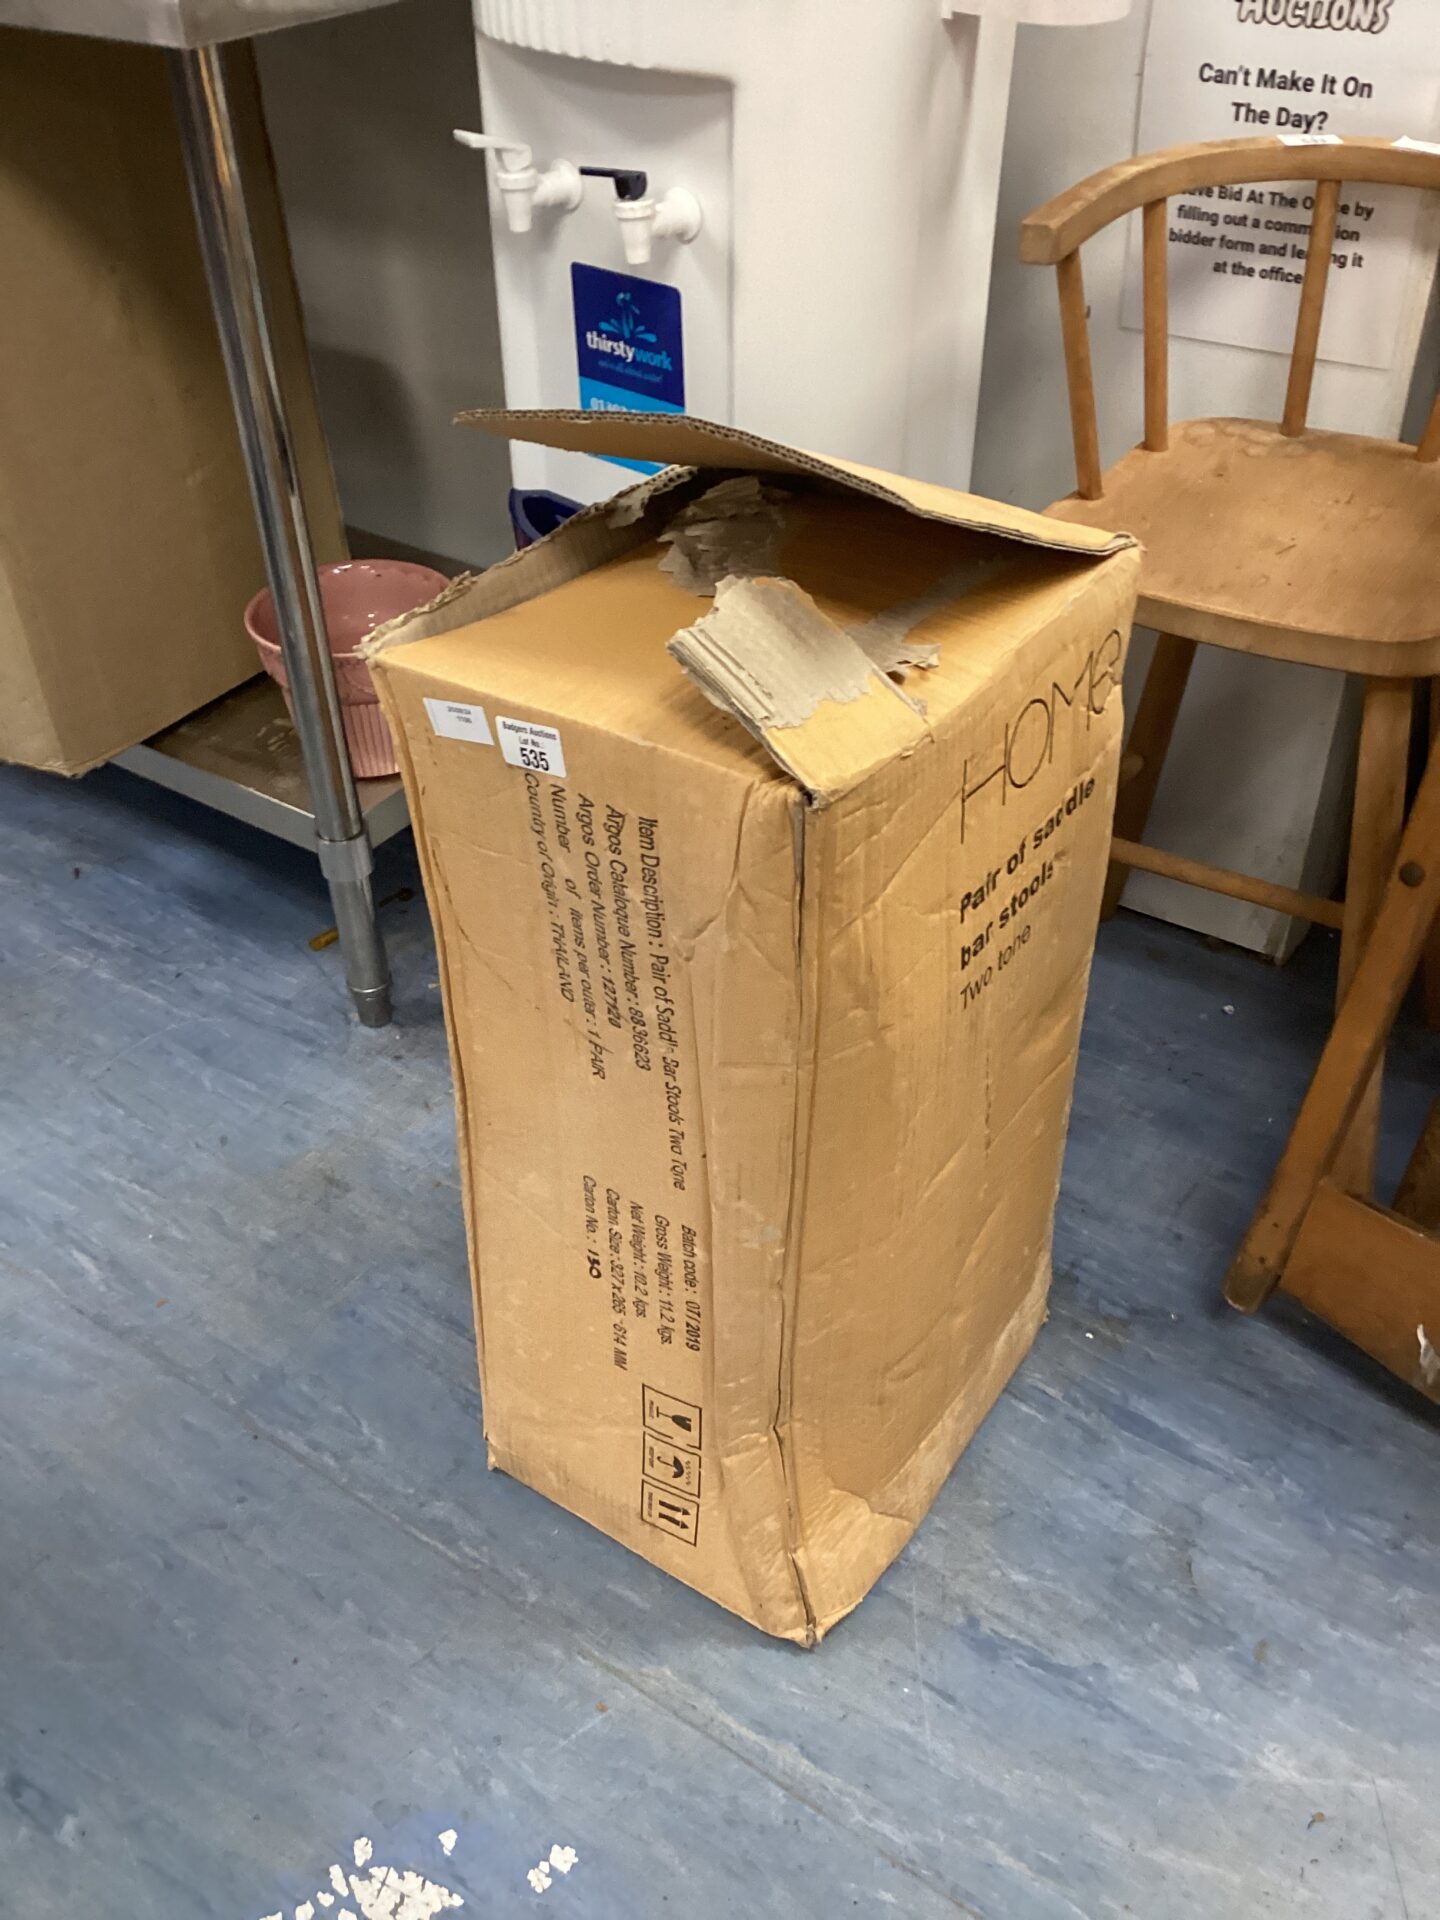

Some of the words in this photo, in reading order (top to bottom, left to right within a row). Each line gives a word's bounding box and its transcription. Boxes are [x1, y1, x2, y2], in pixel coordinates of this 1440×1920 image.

[1199, 63, 1251, 86] Can't
[1256, 68, 1315, 92] Make
[1321, 74, 1336, 95] It
[1343, 76, 1373, 98] On
[1232, 102, 1270, 124] The
[1276, 107, 1328, 134] Day?
[1177, 204, 1219, 227] filling
[1223, 213, 1248, 227] out
[1252, 219, 1260, 229] a
[1218, 185, 1243, 202] Bid
[1246, 189, 1264, 206] At
[1268, 191, 1298, 209] The
[1354, 201, 1374, 221] by
[1169, 228, 1216, 247] bidder
[1219, 235, 1255, 253] form
[1258, 242, 1287, 257] and
[1351, 252, 1364, 268] it
[1213, 260, 1228, 273] at
[1231, 261, 1255, 277] the
[961, 629, 1122, 845] HOME
[520, 746, 549, 771] 535
[550, 783, 572, 853] Number
[575, 792, 596, 847] Argos
[638, 816, 659, 852] Item
[524, 772, 547, 840] Country
[537, 840, 553, 864] of
[551, 920, 574, 1002] THAILAND
[564, 878, 582, 900] of
[584, 851, 603, 901] Order
[960, 867, 1001, 924] Pair
[1006, 835, 1027, 875] of
[568, 906, 586, 950] items
[602, 804, 626, 856] Argos
[628, 1006, 652, 1072] 8836623
[960, 920, 993, 971] bar
[572, 949, 591, 980] per
[650, 953, 670, 984] Pair
[960, 966, 993, 1010] Two
[997, 924, 1031, 972] tone
[654, 985, 674, 1005] of
[590, 1038, 606, 1081] PAIR
[668, 1128, 688, 1155] Two
[583, 1175, 597, 1213] Carton
[606, 1188, 620, 1226] Carton
[629, 1200, 644, 1224] Net
[654, 1214, 670, 1250] Gross
[682, 1224, 698, 1258] Batch
[659, 1297, 676, 1324] 11.2
